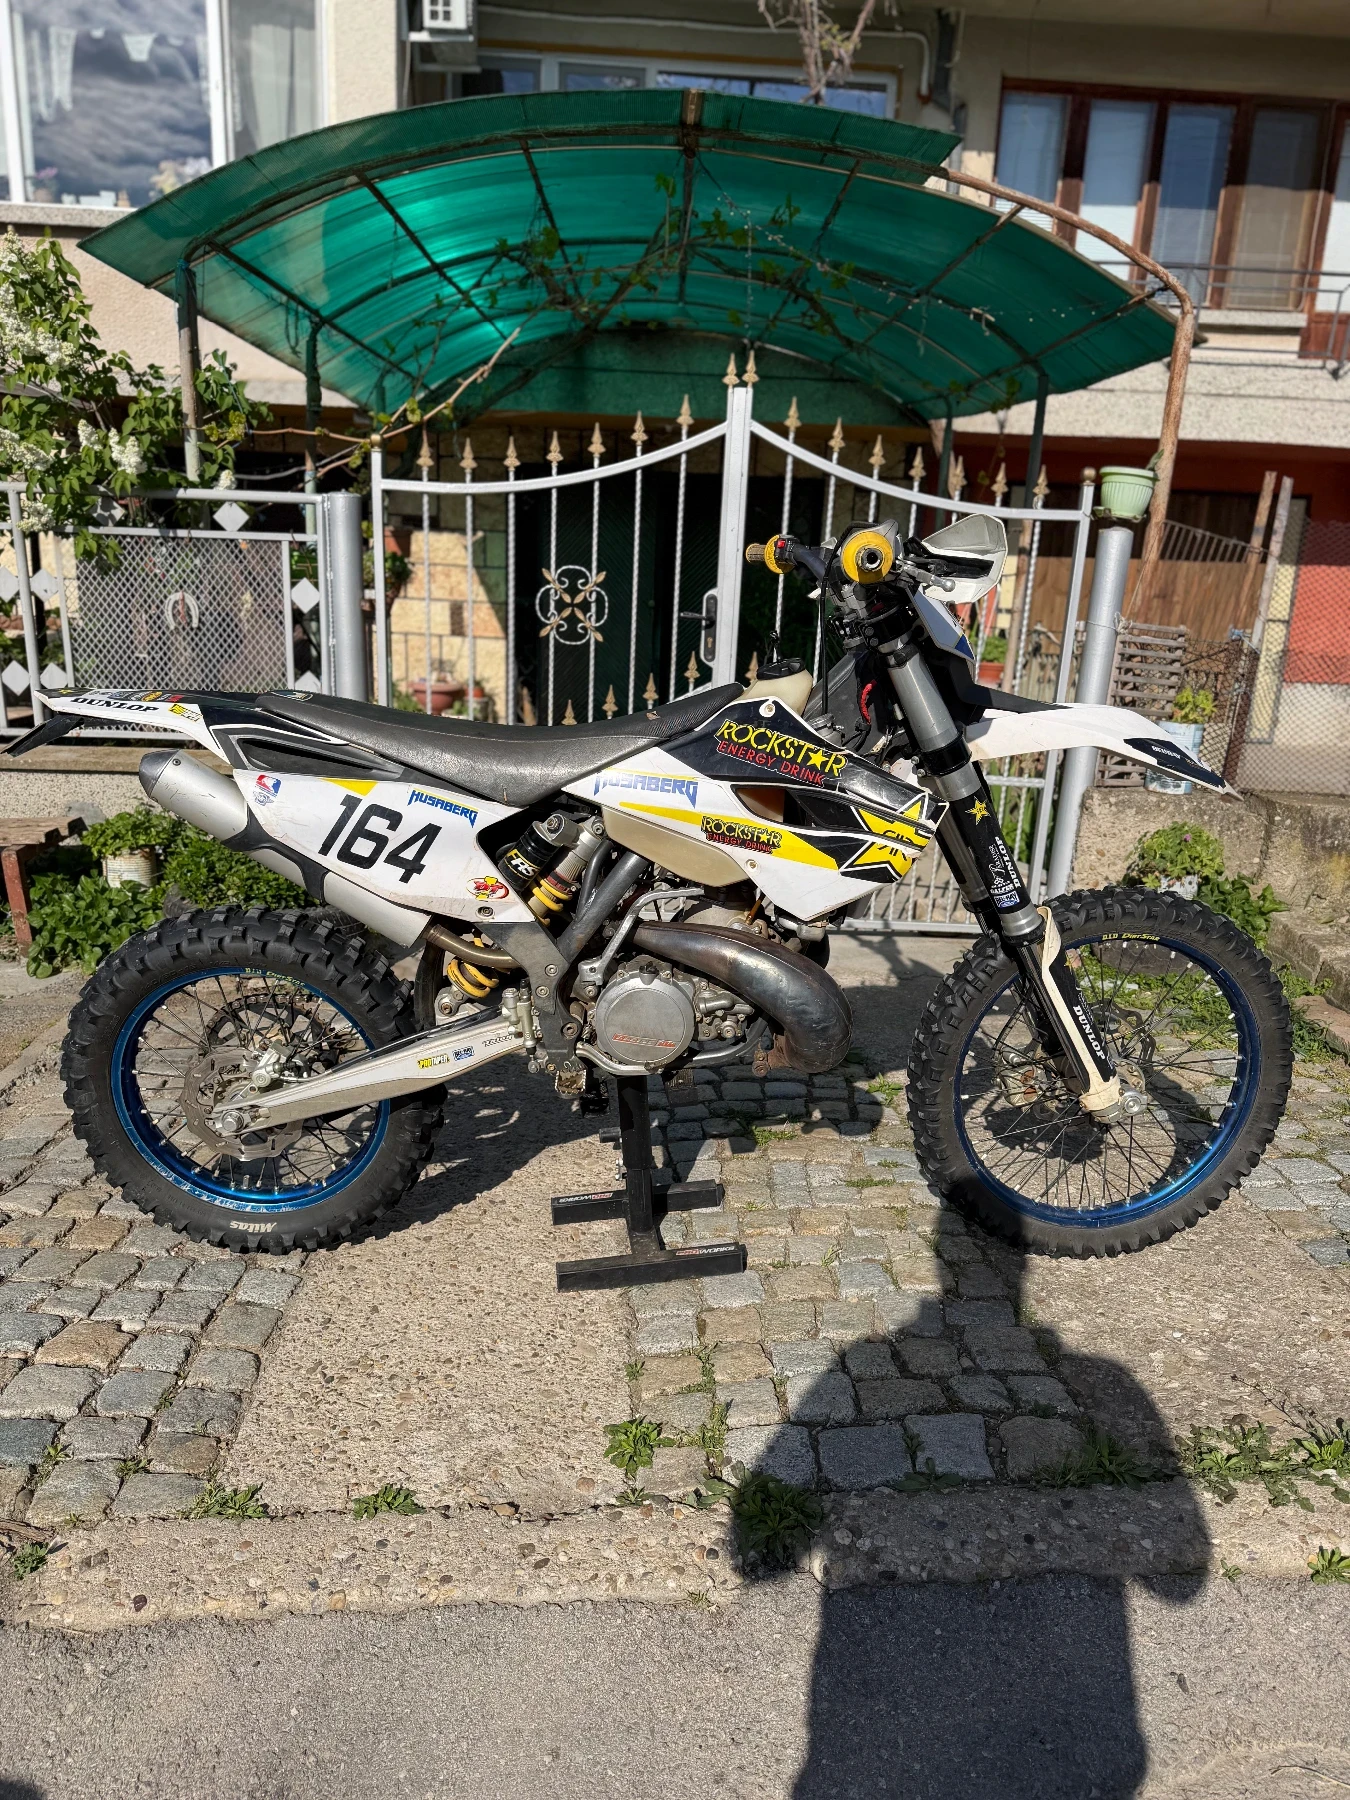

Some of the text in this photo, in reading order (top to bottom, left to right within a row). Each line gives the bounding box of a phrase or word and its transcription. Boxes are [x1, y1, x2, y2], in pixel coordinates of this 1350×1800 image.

[70, 697, 160, 712] DUNLOP
[717, 740, 825, 786] ENERGY DRINK
[407, 789, 479, 828] HUSABERG
[593, 774, 698, 808] HUSABERG
[318, 793, 442, 884] 164
[707, 832, 773, 854] ENERGY DRINK
[994, 836, 1022, 889] DUNLOP
[1073, 1005, 1106, 1060] DUNLOP
[229, 1220, 278, 1233] Mitas
